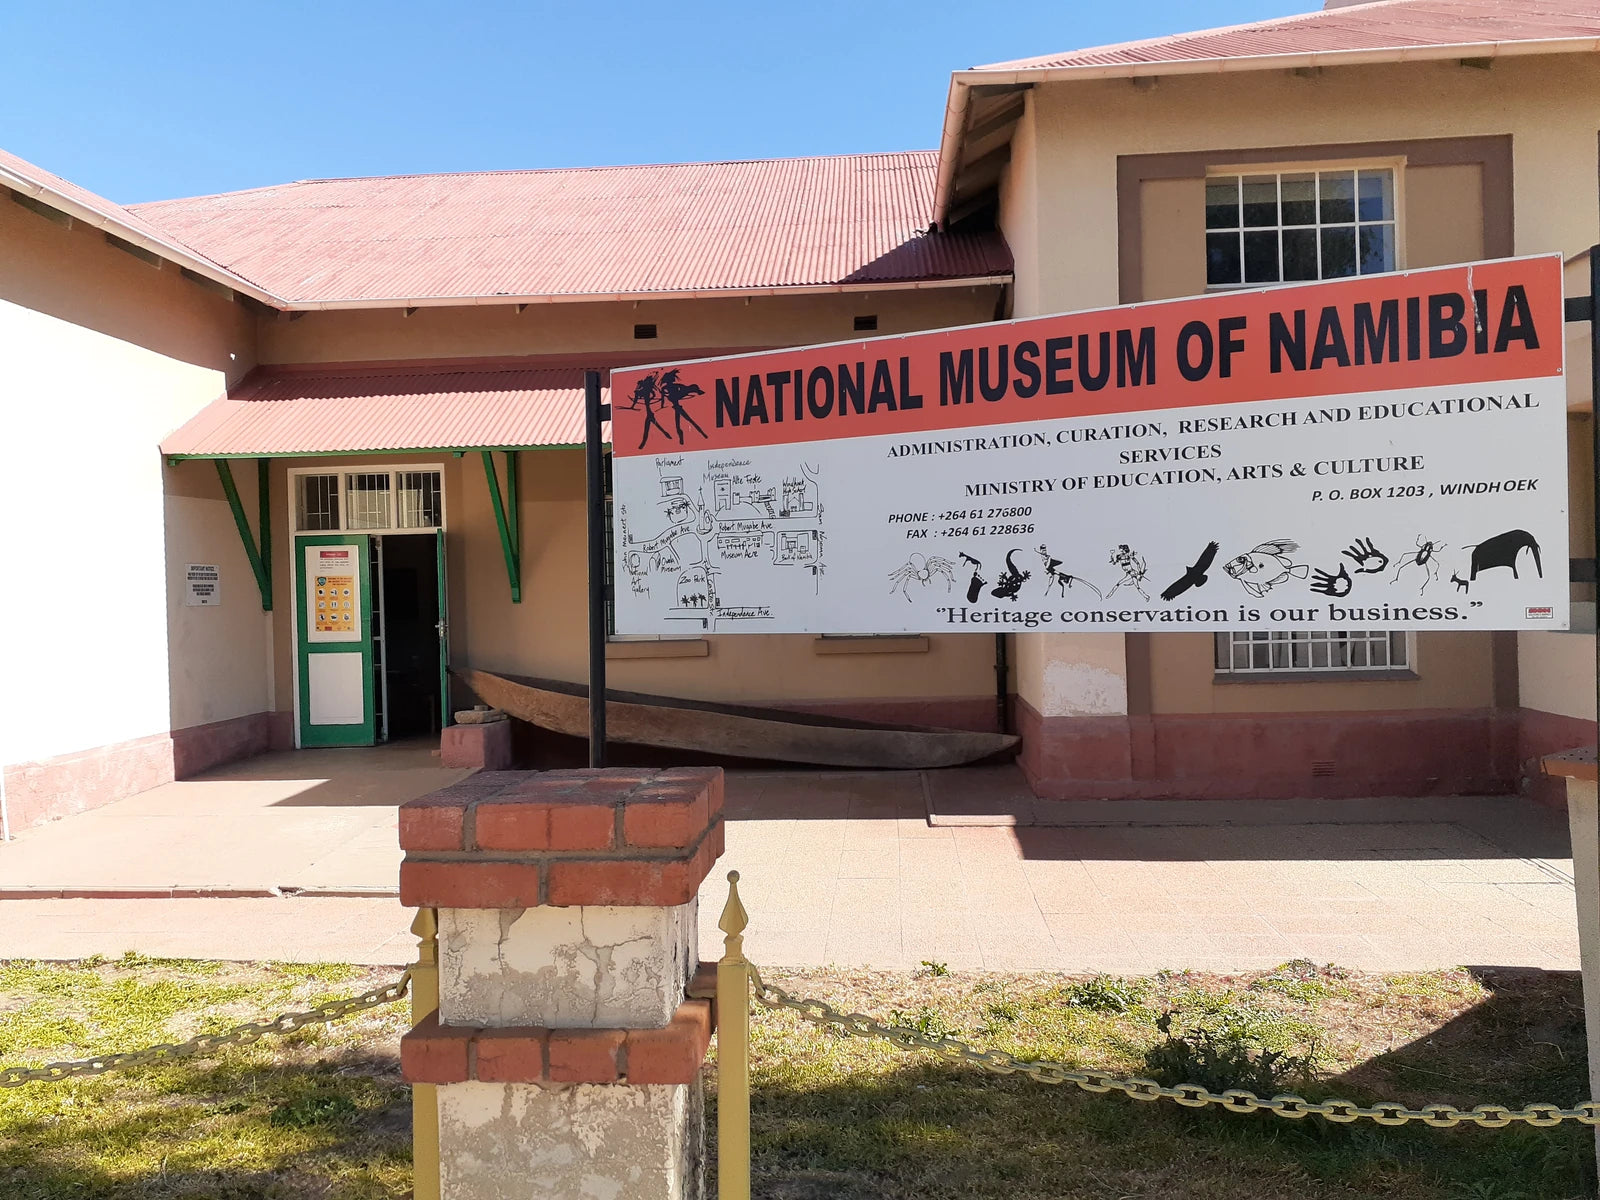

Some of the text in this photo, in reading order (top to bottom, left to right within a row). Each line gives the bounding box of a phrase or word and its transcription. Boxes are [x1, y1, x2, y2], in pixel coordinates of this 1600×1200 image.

[715, 284, 1540, 428] NATIONAL MUSEUM OF NAMIBIA
[887, 393, 1540, 458] ADMINISTRATION, CURATION, RESEARCH AND EDUCATIONAL
[655, 456, 684, 468] Parliament
[1119, 444, 1222, 465] SERVICES
[707, 458, 752, 472] Independence
[964, 455, 1425, 497] MINISTRY OF EDUCATION, ARTS & CULTURE
[1311, 490, 1323, 502] P.
[1328, 489, 1345, 501] O.
[1349, 487, 1382, 500] BOX
[1386, 485, 1425, 499] 1203
[1439, 478, 1539, 496] WINDHOEK
[888, 512, 929, 524] PHONE
[938, 510, 966, 521] +264
[969, 509, 984, 519] 61
[987, 506, 1033, 518] 276800
[718, 521, 735, 532] Robert
[760, 520, 773, 529] Ave
[906, 528, 928, 539] FAX
[940, 526, 969, 538] +264
[972, 526, 987, 537] 61
[989, 523, 1035, 536] 228636
[642, 542, 659, 553] Robert
[680, 525, 691, 534] Ave
[720, 548, 759, 560] Museum Acre
[631, 576, 642, 586] Art
[679, 574, 706, 585] Zoo Park
[631, 585, 651, 600] Gallery
[717, 608, 756, 620] Independence
[1060, 605, 1230, 623] conservation
[1238, 605, 1261, 622] is
[1270, 608, 1320, 622] our
